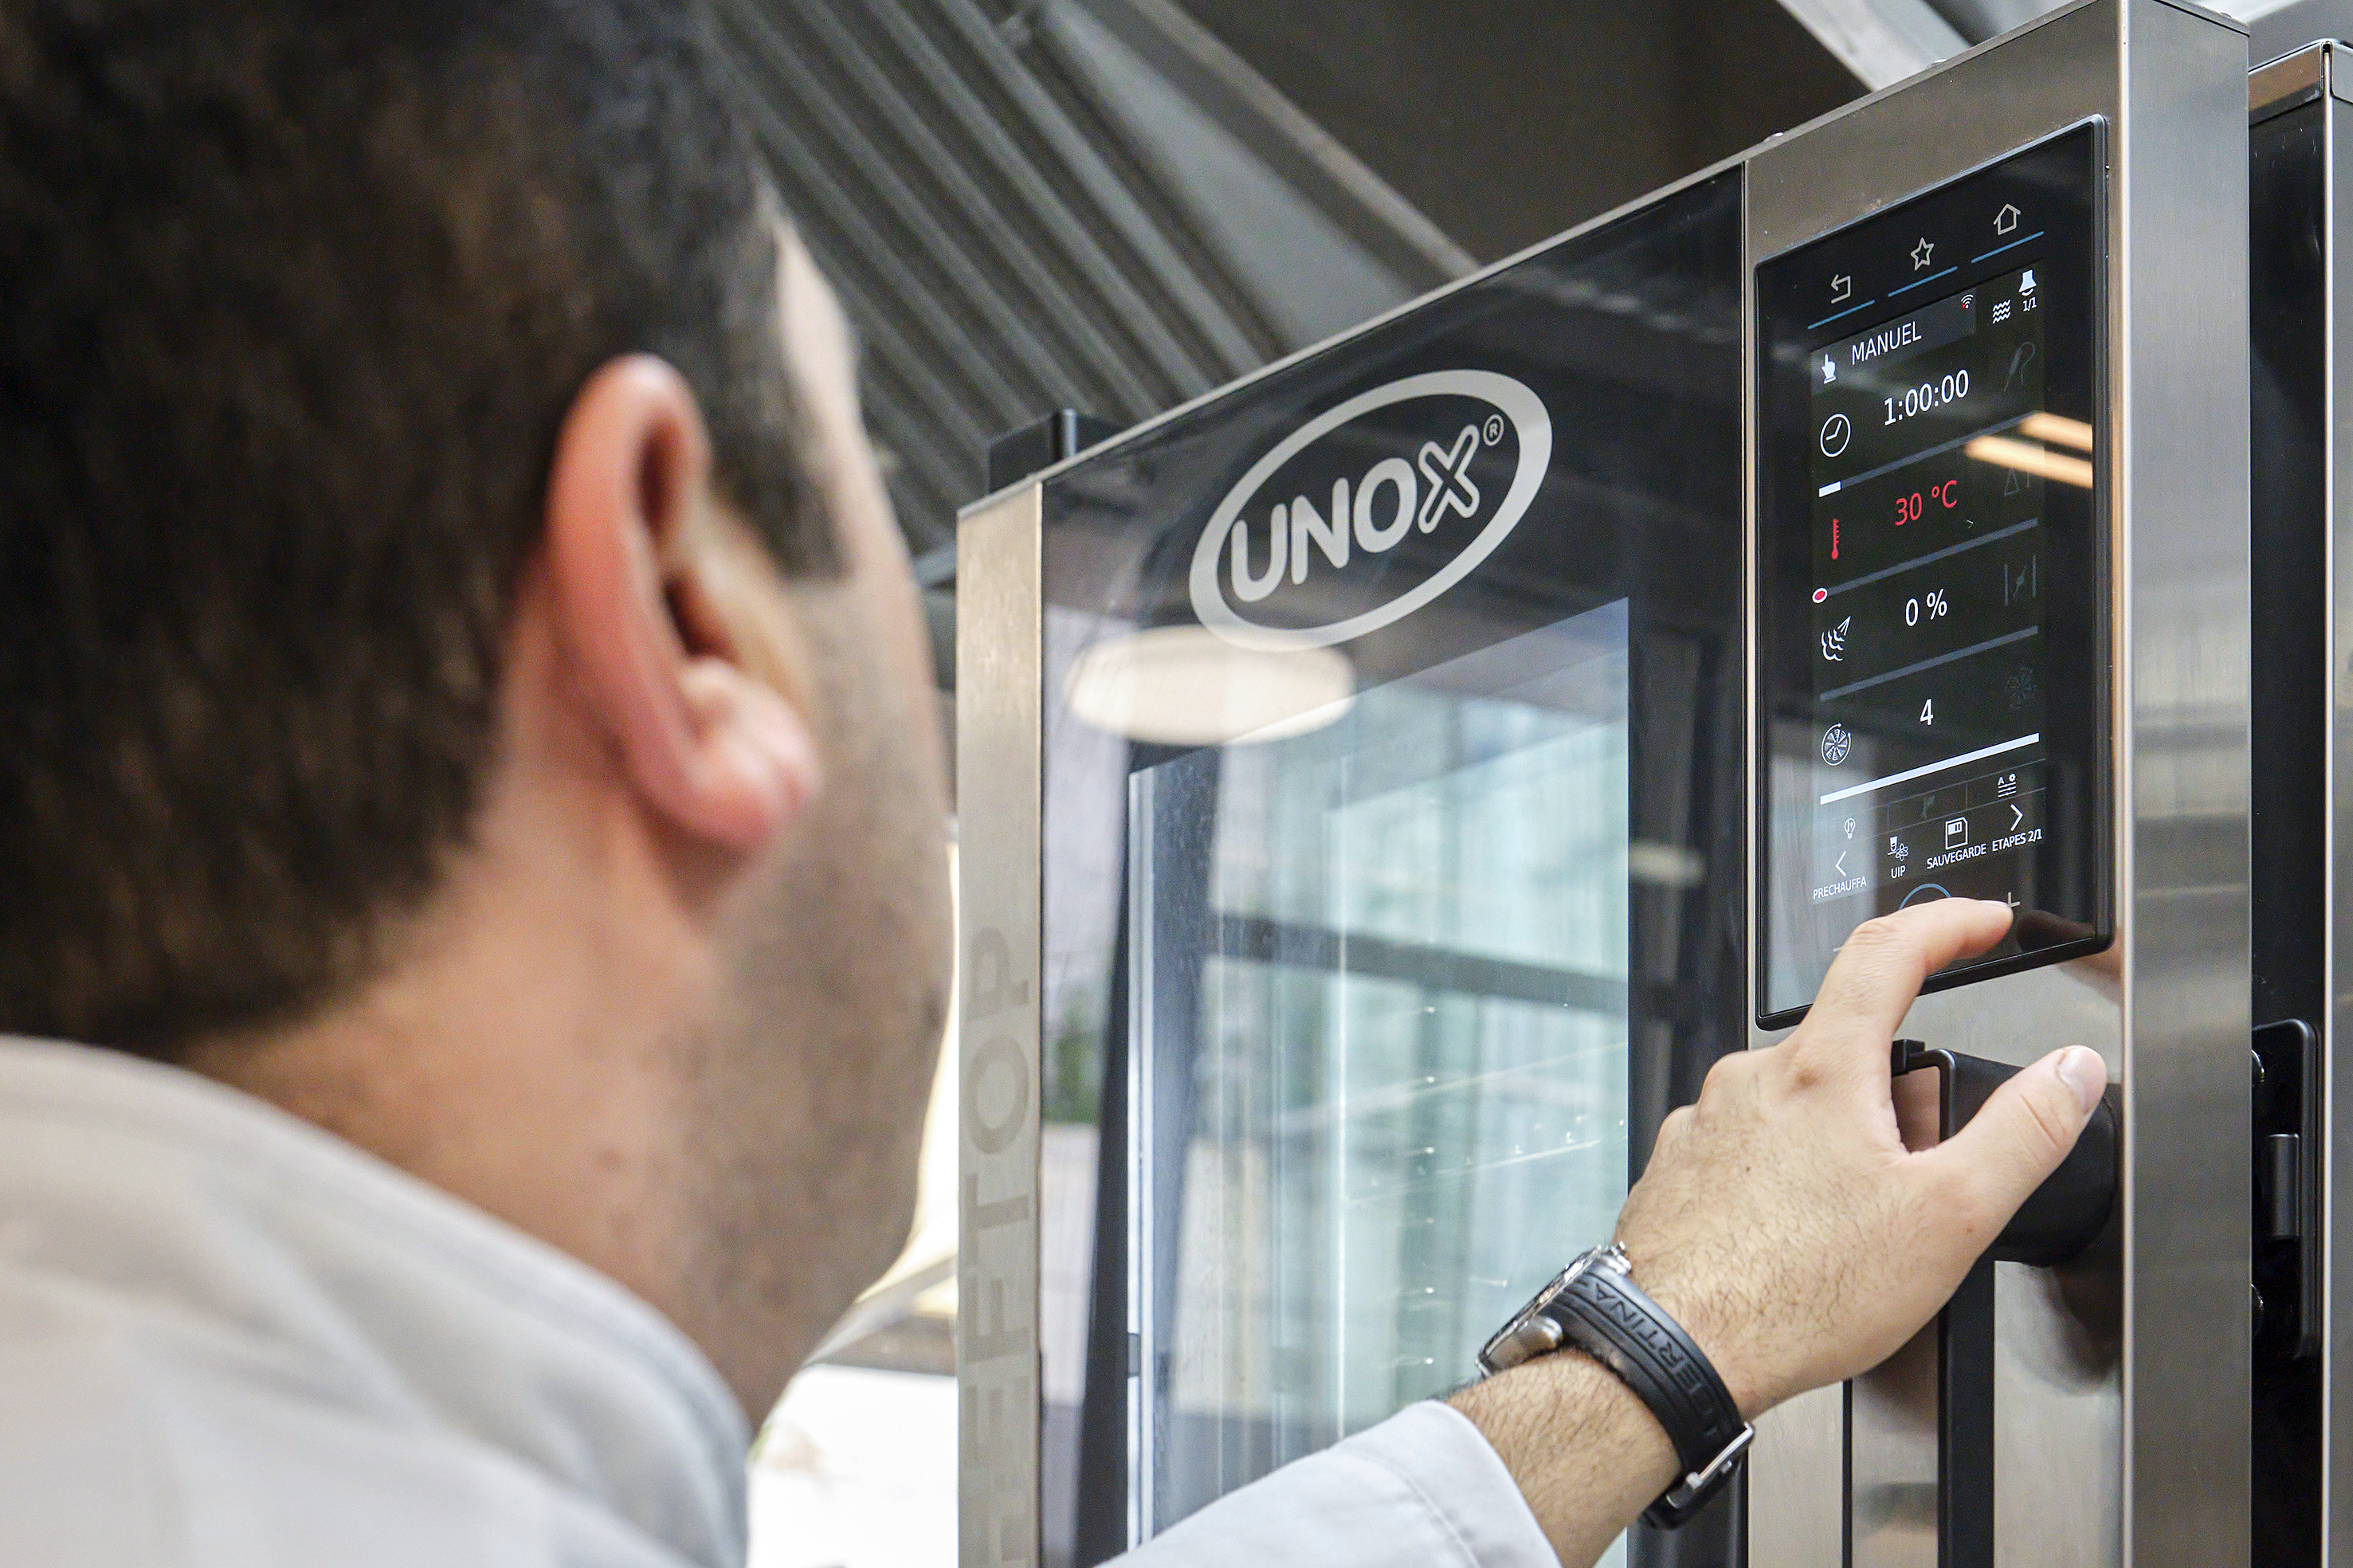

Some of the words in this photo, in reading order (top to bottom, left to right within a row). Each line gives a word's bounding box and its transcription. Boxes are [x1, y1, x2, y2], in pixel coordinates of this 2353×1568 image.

[1851, 321, 1922, 365] MANUEL
[1884, 369, 1969, 426] 1:00:00
[1895, 492, 1923, 526] 30
[1931, 480, 1958, 509] °C
[1905, 598, 1919, 627] 0
[1927, 588, 1947, 621] %
[1920, 699, 1934, 726] 4
[1992, 832, 2026, 852] ETAPES
[2027, 828, 2043, 843] 2/1
[1927, 843, 1987, 870] SAUVEGARDE
[1891, 865, 1906, 880] UIP
[1813, 876, 1867, 900] PRECHAUFFA
